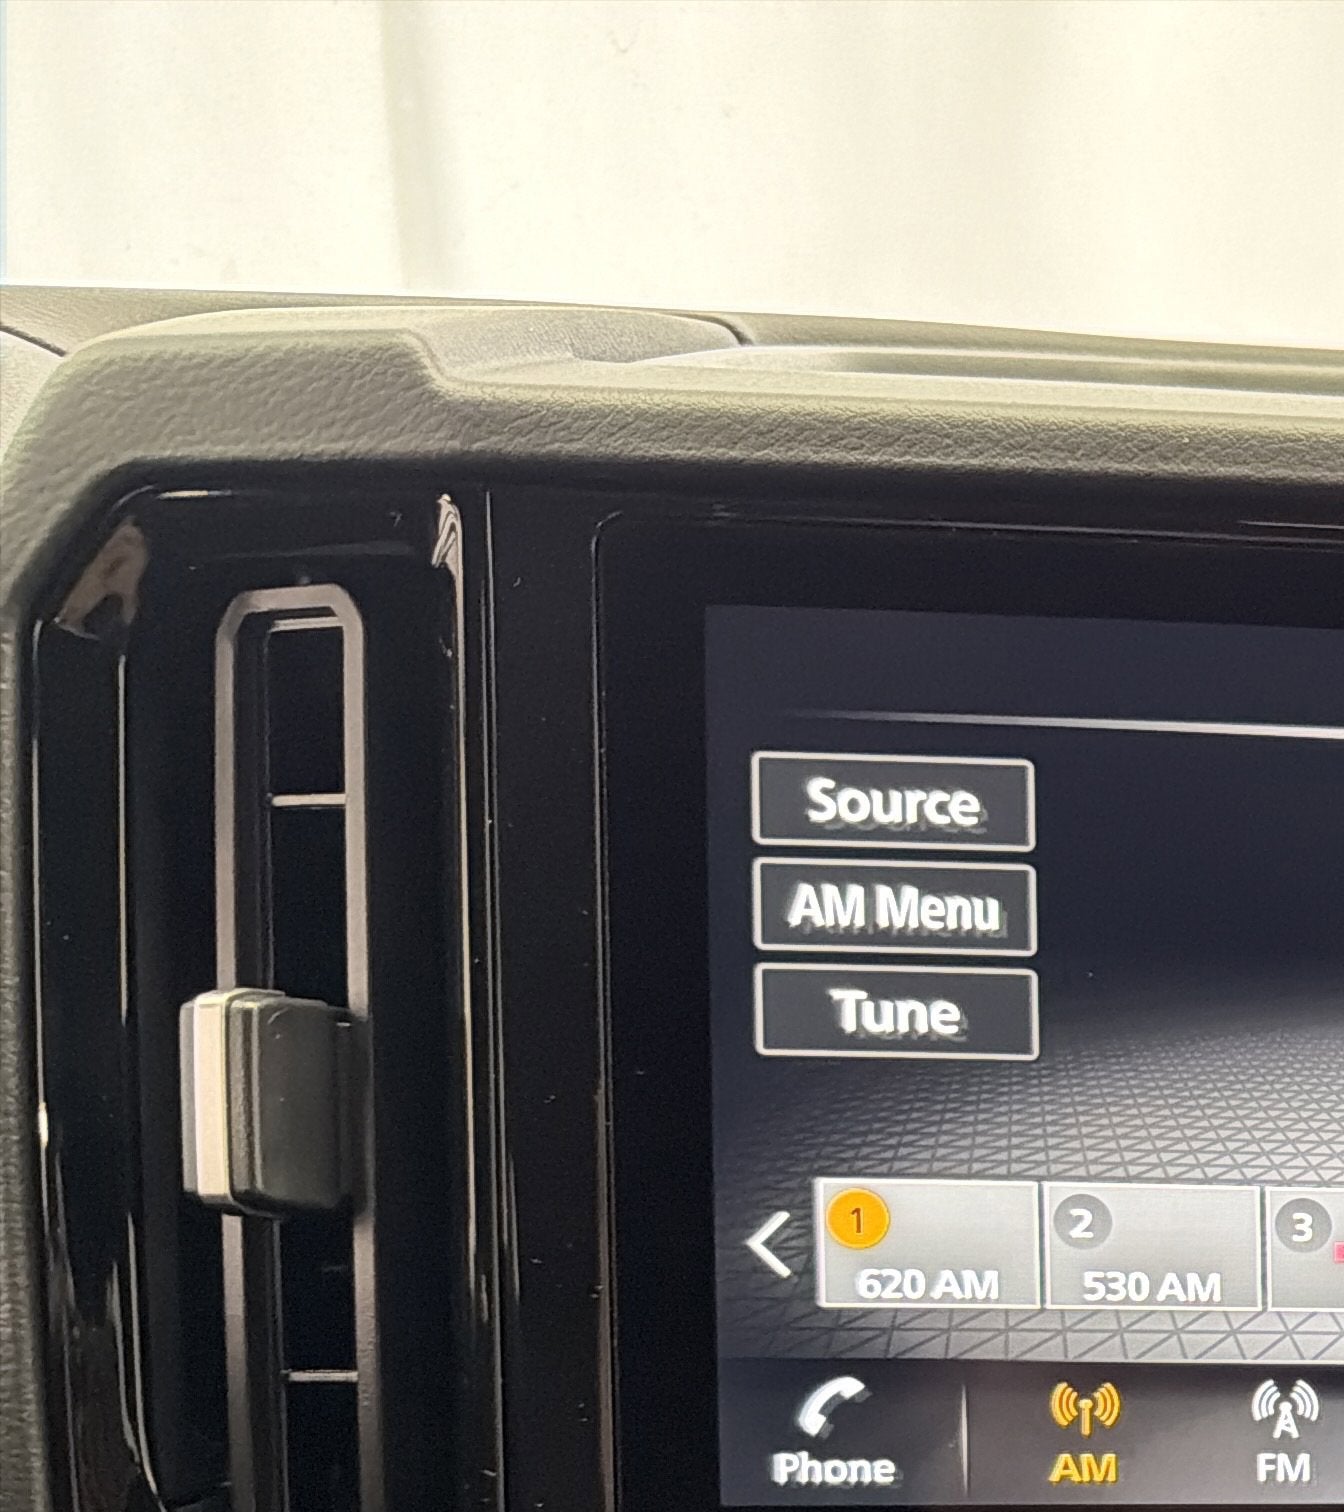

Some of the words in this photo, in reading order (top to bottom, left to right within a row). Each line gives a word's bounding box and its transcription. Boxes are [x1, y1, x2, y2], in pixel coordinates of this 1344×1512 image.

[807, 776, 983, 828] Source
[788, 883, 866, 929] AM
[874, 887, 1003, 934] Menu
[830, 989, 963, 1036] Tune
[851, 1207, 864, 1233] 1
[1069, 1211, 1093, 1238] 2
[1291, 1212, 1313, 1242] 3
[857, 1270, 926, 1300] 620
[932, 1271, 999, 1300] AM
[1082, 1272, 1150, 1302] 530
[1157, 1274, 1221, 1302] AM
[773, 1453, 896, 1485] Phone
[1049, 1453, 1117, 1483] AM
[1257, 1453, 1311, 1482] FM
